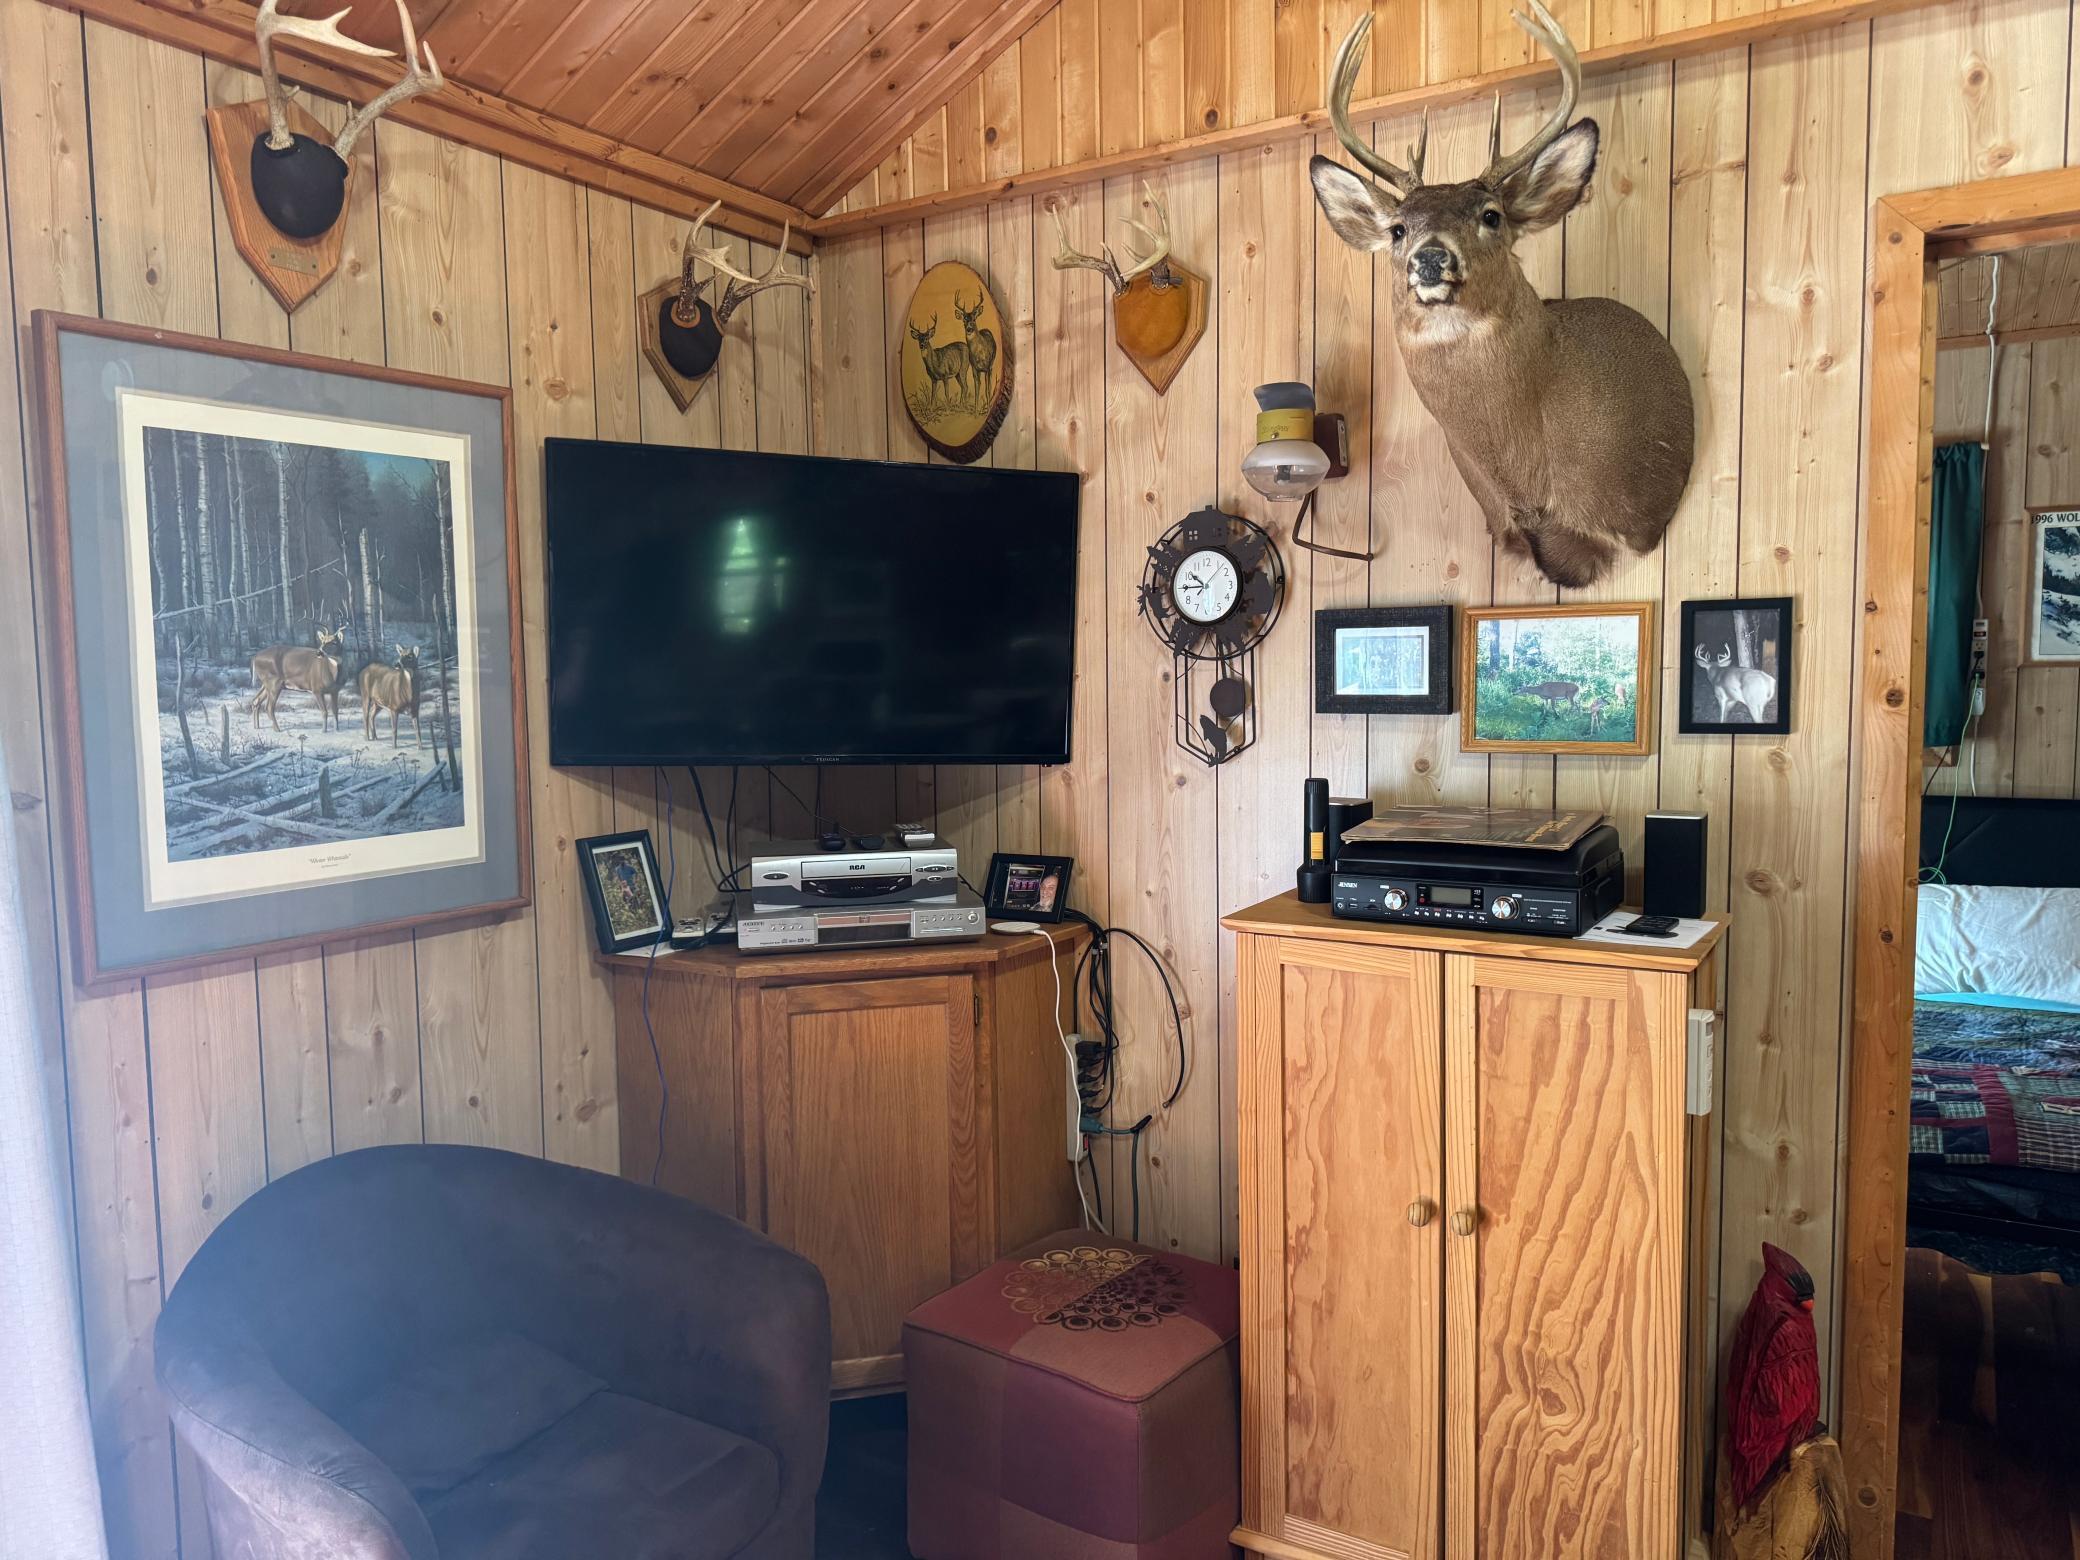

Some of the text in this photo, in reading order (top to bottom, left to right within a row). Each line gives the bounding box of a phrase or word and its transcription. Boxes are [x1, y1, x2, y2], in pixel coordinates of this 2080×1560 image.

[2031, 514, 2053, 524] 1996
[1194, 562, 1200, 571] 11
[1203, 557, 1212, 567] 12
[1185, 571, 1193, 581] 10
[1223, 567, 1229, 577] 2
[1182, 584, 1188, 593] 9
[1228, 580, 1233, 590] 3
[1185, 595, 1191, 605] 8
[1224, 593, 1230, 602] 4
[1194, 603, 1200, 613] 7
[1216, 602, 1222, 612] 5
